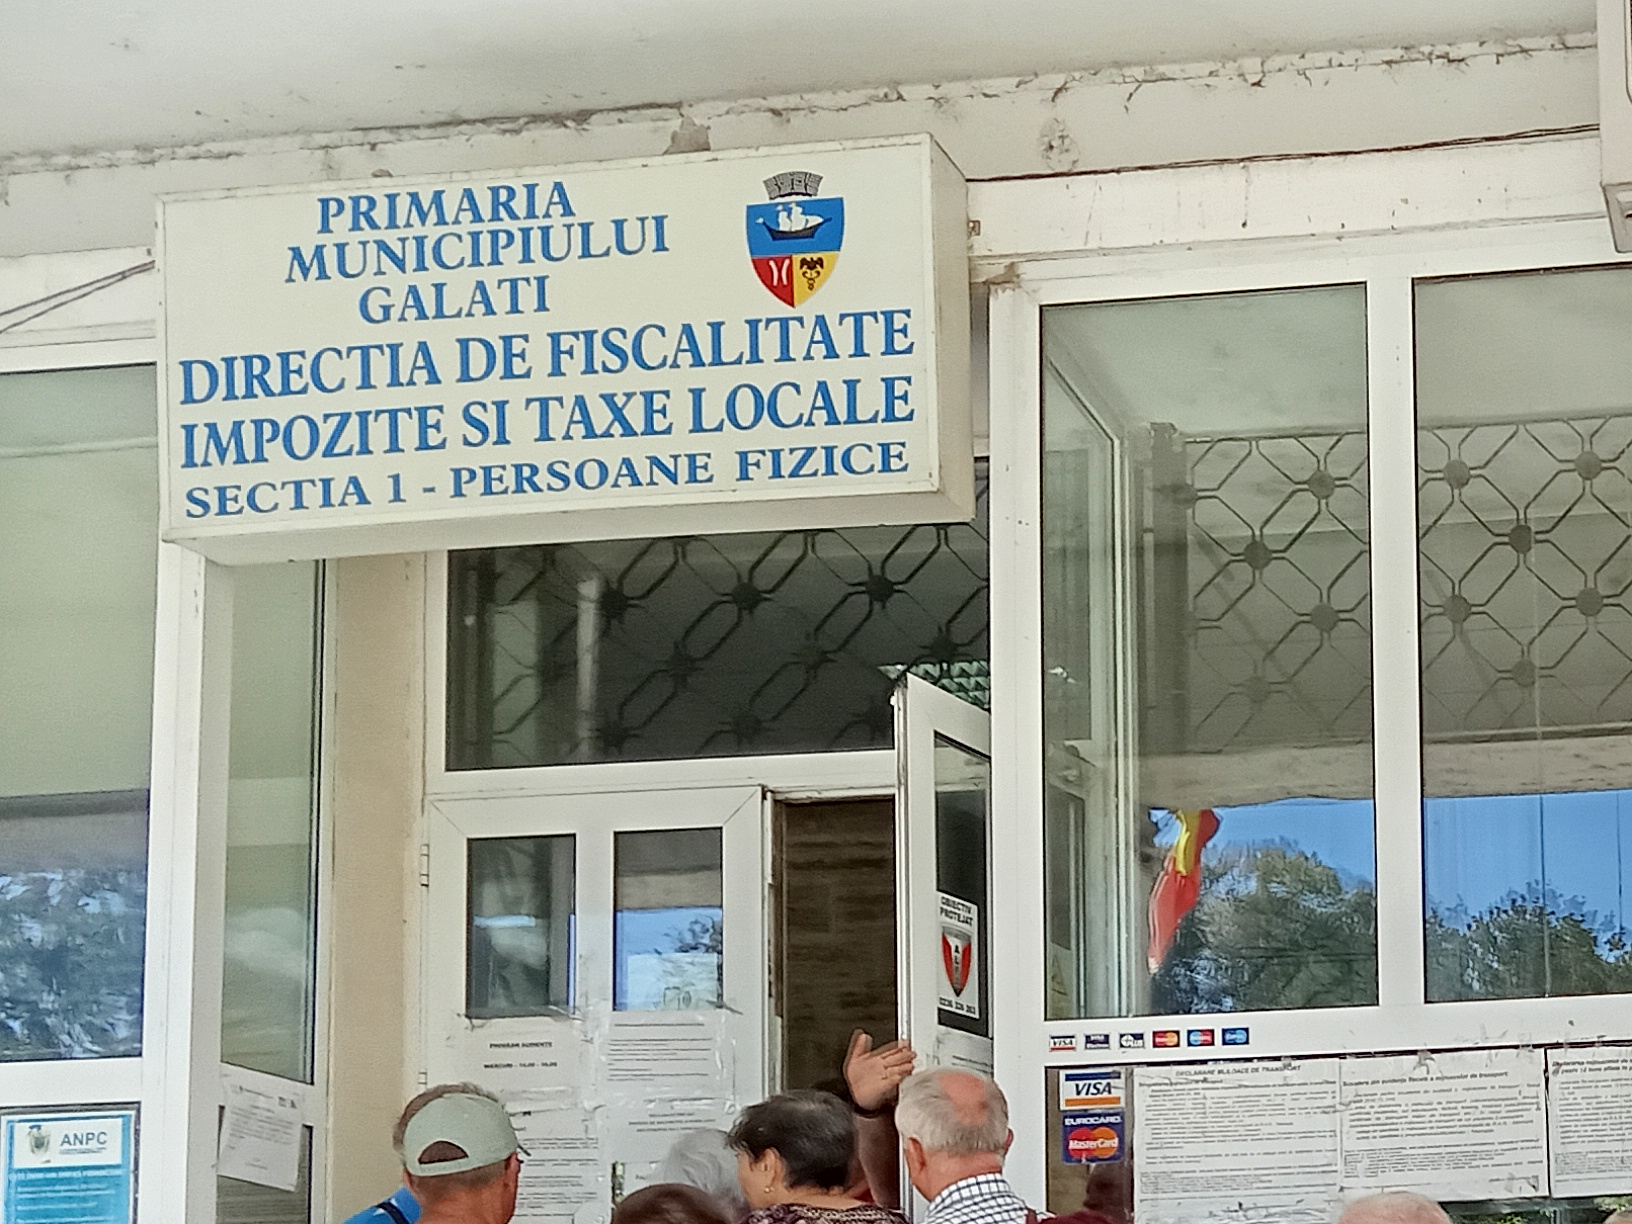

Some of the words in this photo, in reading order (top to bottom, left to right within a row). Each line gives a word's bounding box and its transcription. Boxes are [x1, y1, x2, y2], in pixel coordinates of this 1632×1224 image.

[317, 181, 575, 234] PRIMARIA
[284, 214, 669, 282] MUNICIPIULUI
[358, 275, 550, 324] GALATI
[179, 340, 442, 405] DIRECTIA
[457, 334, 532, 383] DE
[548, 308, 914, 378] FISCALITATE
[181, 404, 447, 469] IMPOZITE
[462, 399, 510, 448] SI
[525, 389, 673, 442] TAXE
[688, 375, 914, 434] LOCALE
[185, 475, 371, 519] SECTIA
[388, 474, 407, 503] 1
[450, 452, 715, 499] PERSOANE
[737, 441, 909, 482] FIZICE
[1052, 1038, 1073, 1047] VISA
[1074, 1081, 1113, 1096] VISA
[60, 1131, 108, 1147] ANPC
[1064, 1116, 1121, 1127] EUROCARD
[1068, 1136, 1118, 1150] MasterCard
